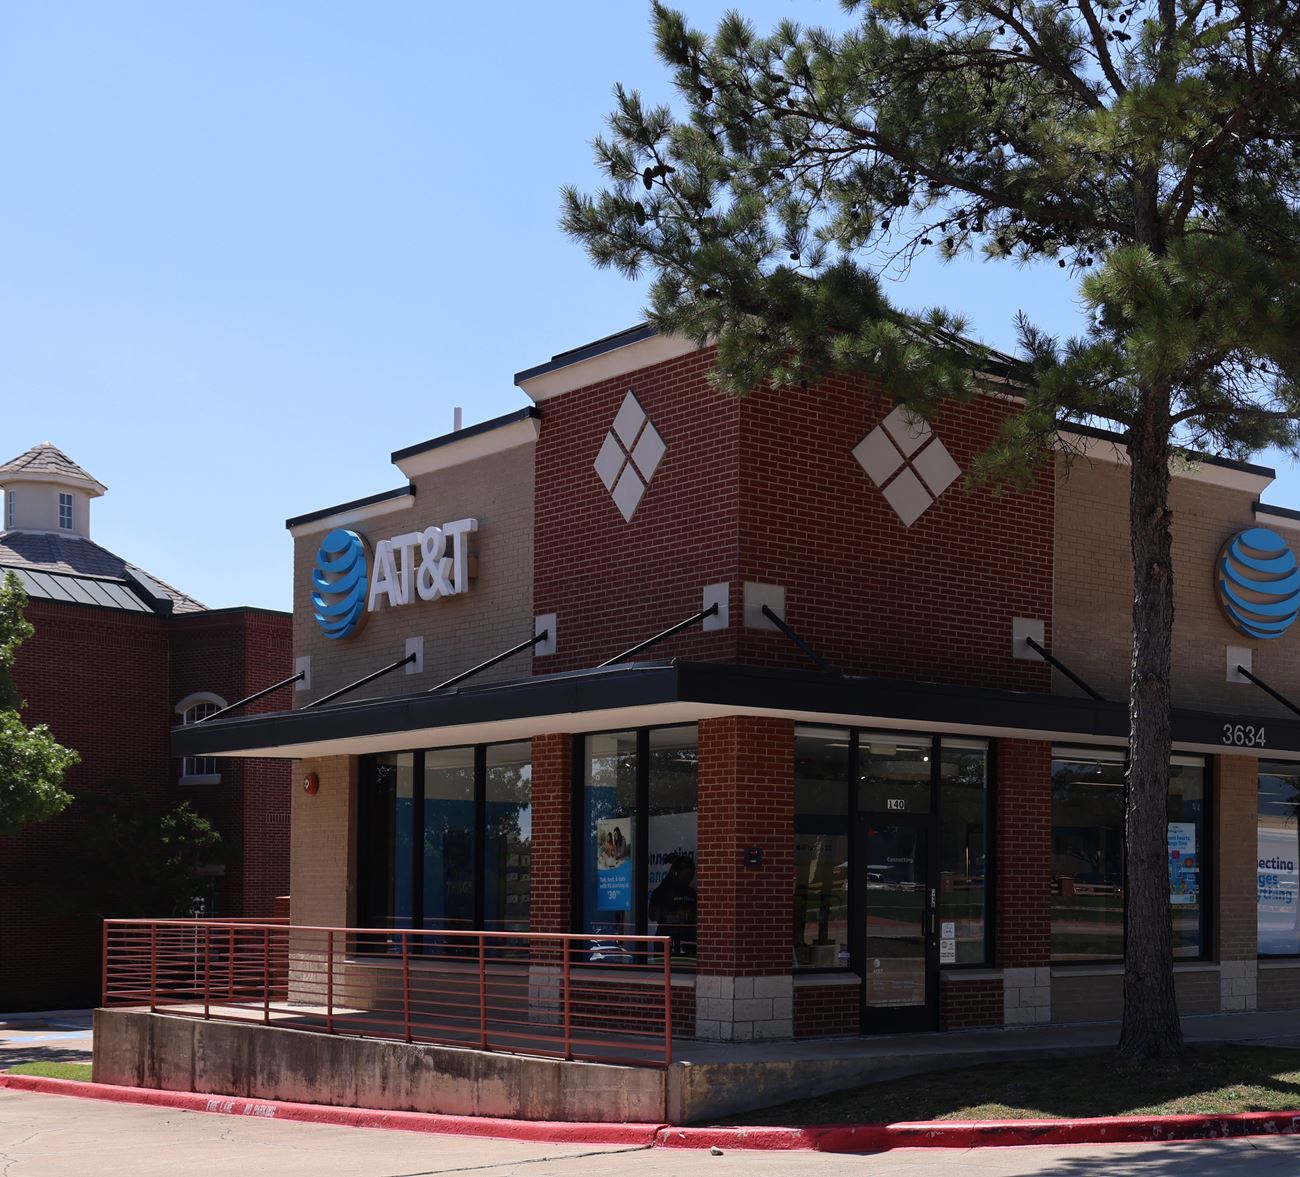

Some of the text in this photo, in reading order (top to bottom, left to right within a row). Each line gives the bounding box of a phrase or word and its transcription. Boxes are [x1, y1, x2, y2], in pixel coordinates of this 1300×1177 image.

[368, 518, 478, 612] AT&T
[1222, 723, 1266, 747] 3634
[889, 800, 904, 808] 140
[1257, 857, 1294, 873] ecting
